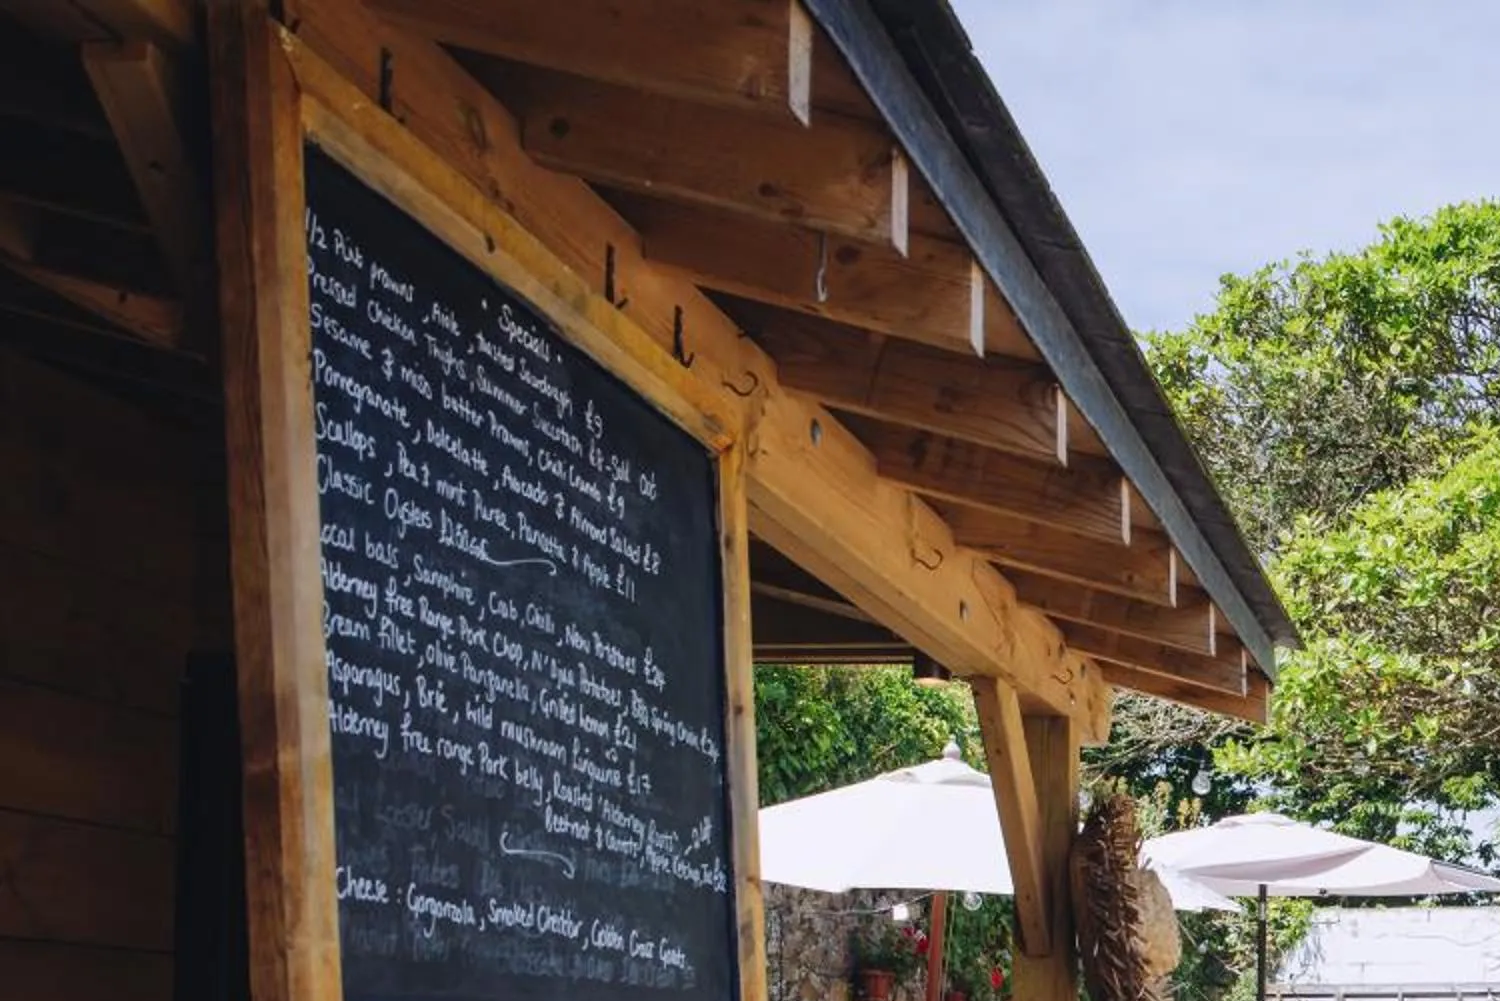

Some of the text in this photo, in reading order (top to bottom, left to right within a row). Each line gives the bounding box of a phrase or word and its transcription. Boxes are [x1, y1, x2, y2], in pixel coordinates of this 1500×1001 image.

[305, 207, 327, 249] 1/2
[333, 228, 363, 269] Pint
[585, 400, 603, 439] £9
[367, 300, 418, 346] Chicken
[476, 364, 528, 416] Summer
[498, 303, 550, 363] Specials
[310, 302, 373, 360] Sesame
[400, 361, 433, 401] miso
[441, 382, 485, 429] butter
[607, 481, 625, 521] £9
[316, 453, 375, 505] Classic
[384, 487, 432, 540] Oysters
[320, 523, 355, 552] ocal
[396, 440, 419, 482] Pea
[436, 473, 467, 507] mint
[517, 511, 567, 564] Pancetta
[584, 554, 611, 590] Apple
[615, 563, 635, 603] £11
[502, 464, 549, 506] Avocado
[570, 505, 607, 544] Almond
[609, 527, 641, 565] Salad
[643, 543, 662, 576] £8
[459, 615, 489, 653] Pork
[327, 699, 389, 759] Alderney
[437, 737, 475, 776] range
[477, 741, 509, 781] Pork
[553, 770, 593, 812] Roasted
[501, 720, 567, 766] mushroom
[627, 759, 651, 794] £17
[545, 805, 590, 841] Beetroot
[488, 898, 534, 927] Smoked
